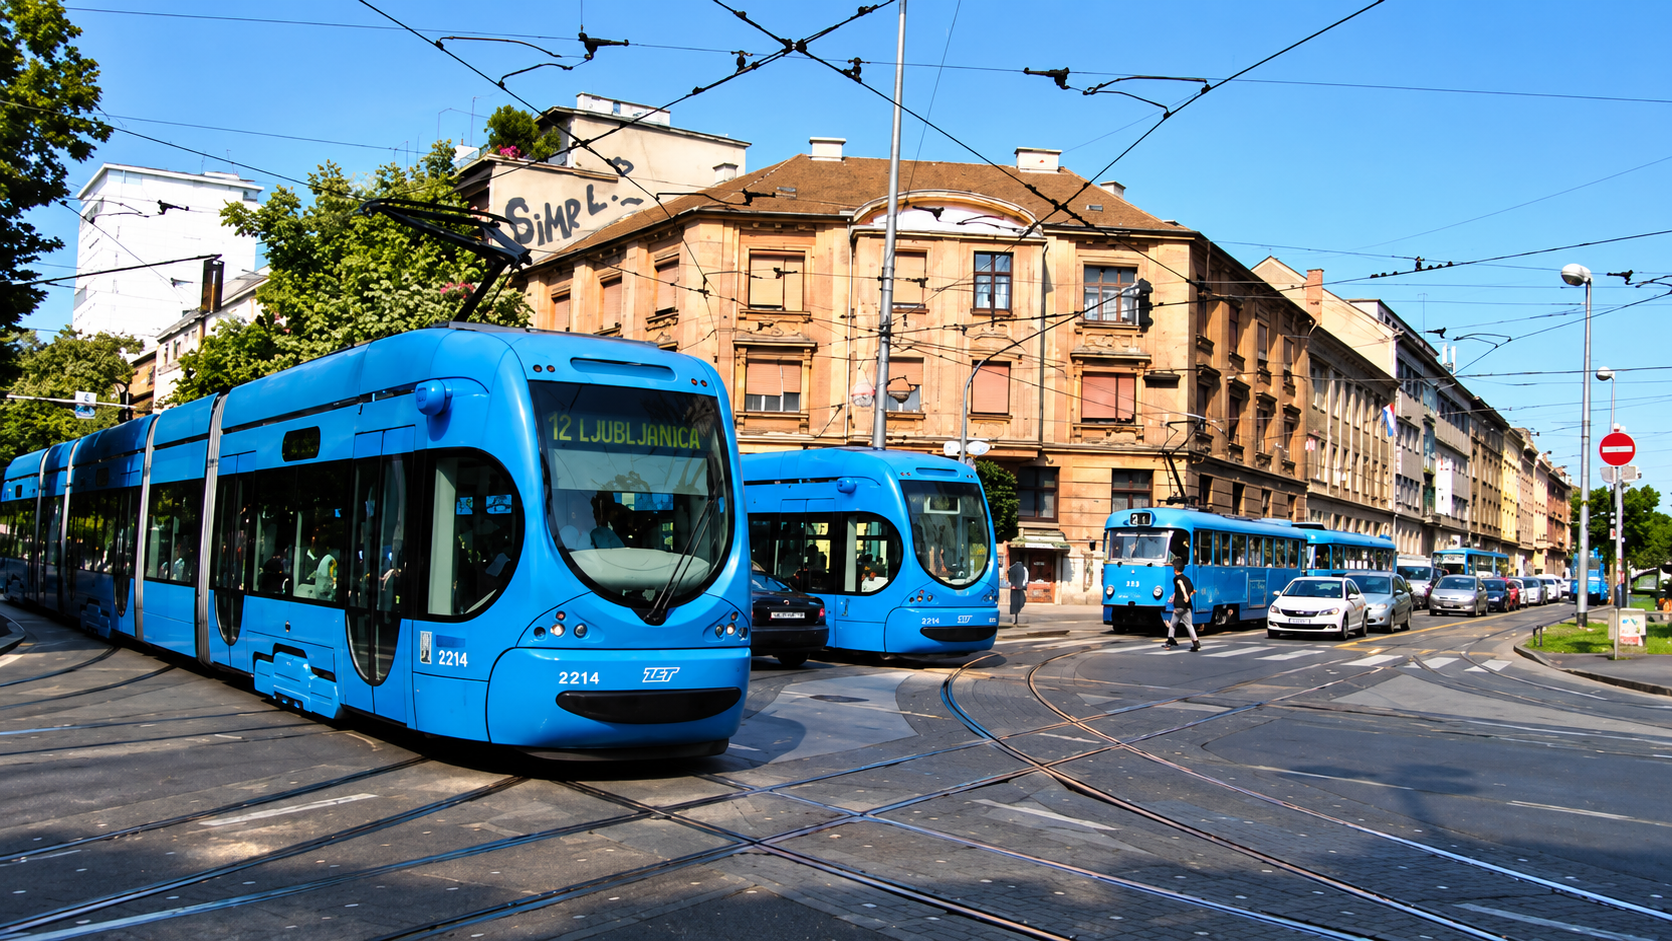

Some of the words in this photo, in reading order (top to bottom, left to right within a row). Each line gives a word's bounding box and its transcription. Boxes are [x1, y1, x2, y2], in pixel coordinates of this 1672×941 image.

[549, 411, 572, 441] 12
[579, 418, 701, 449] LJUBLJANICA
[438, 649, 468, 668] 2214
[558, 671, 599, 685] 2214
[642, 666, 680, 683] ZET
